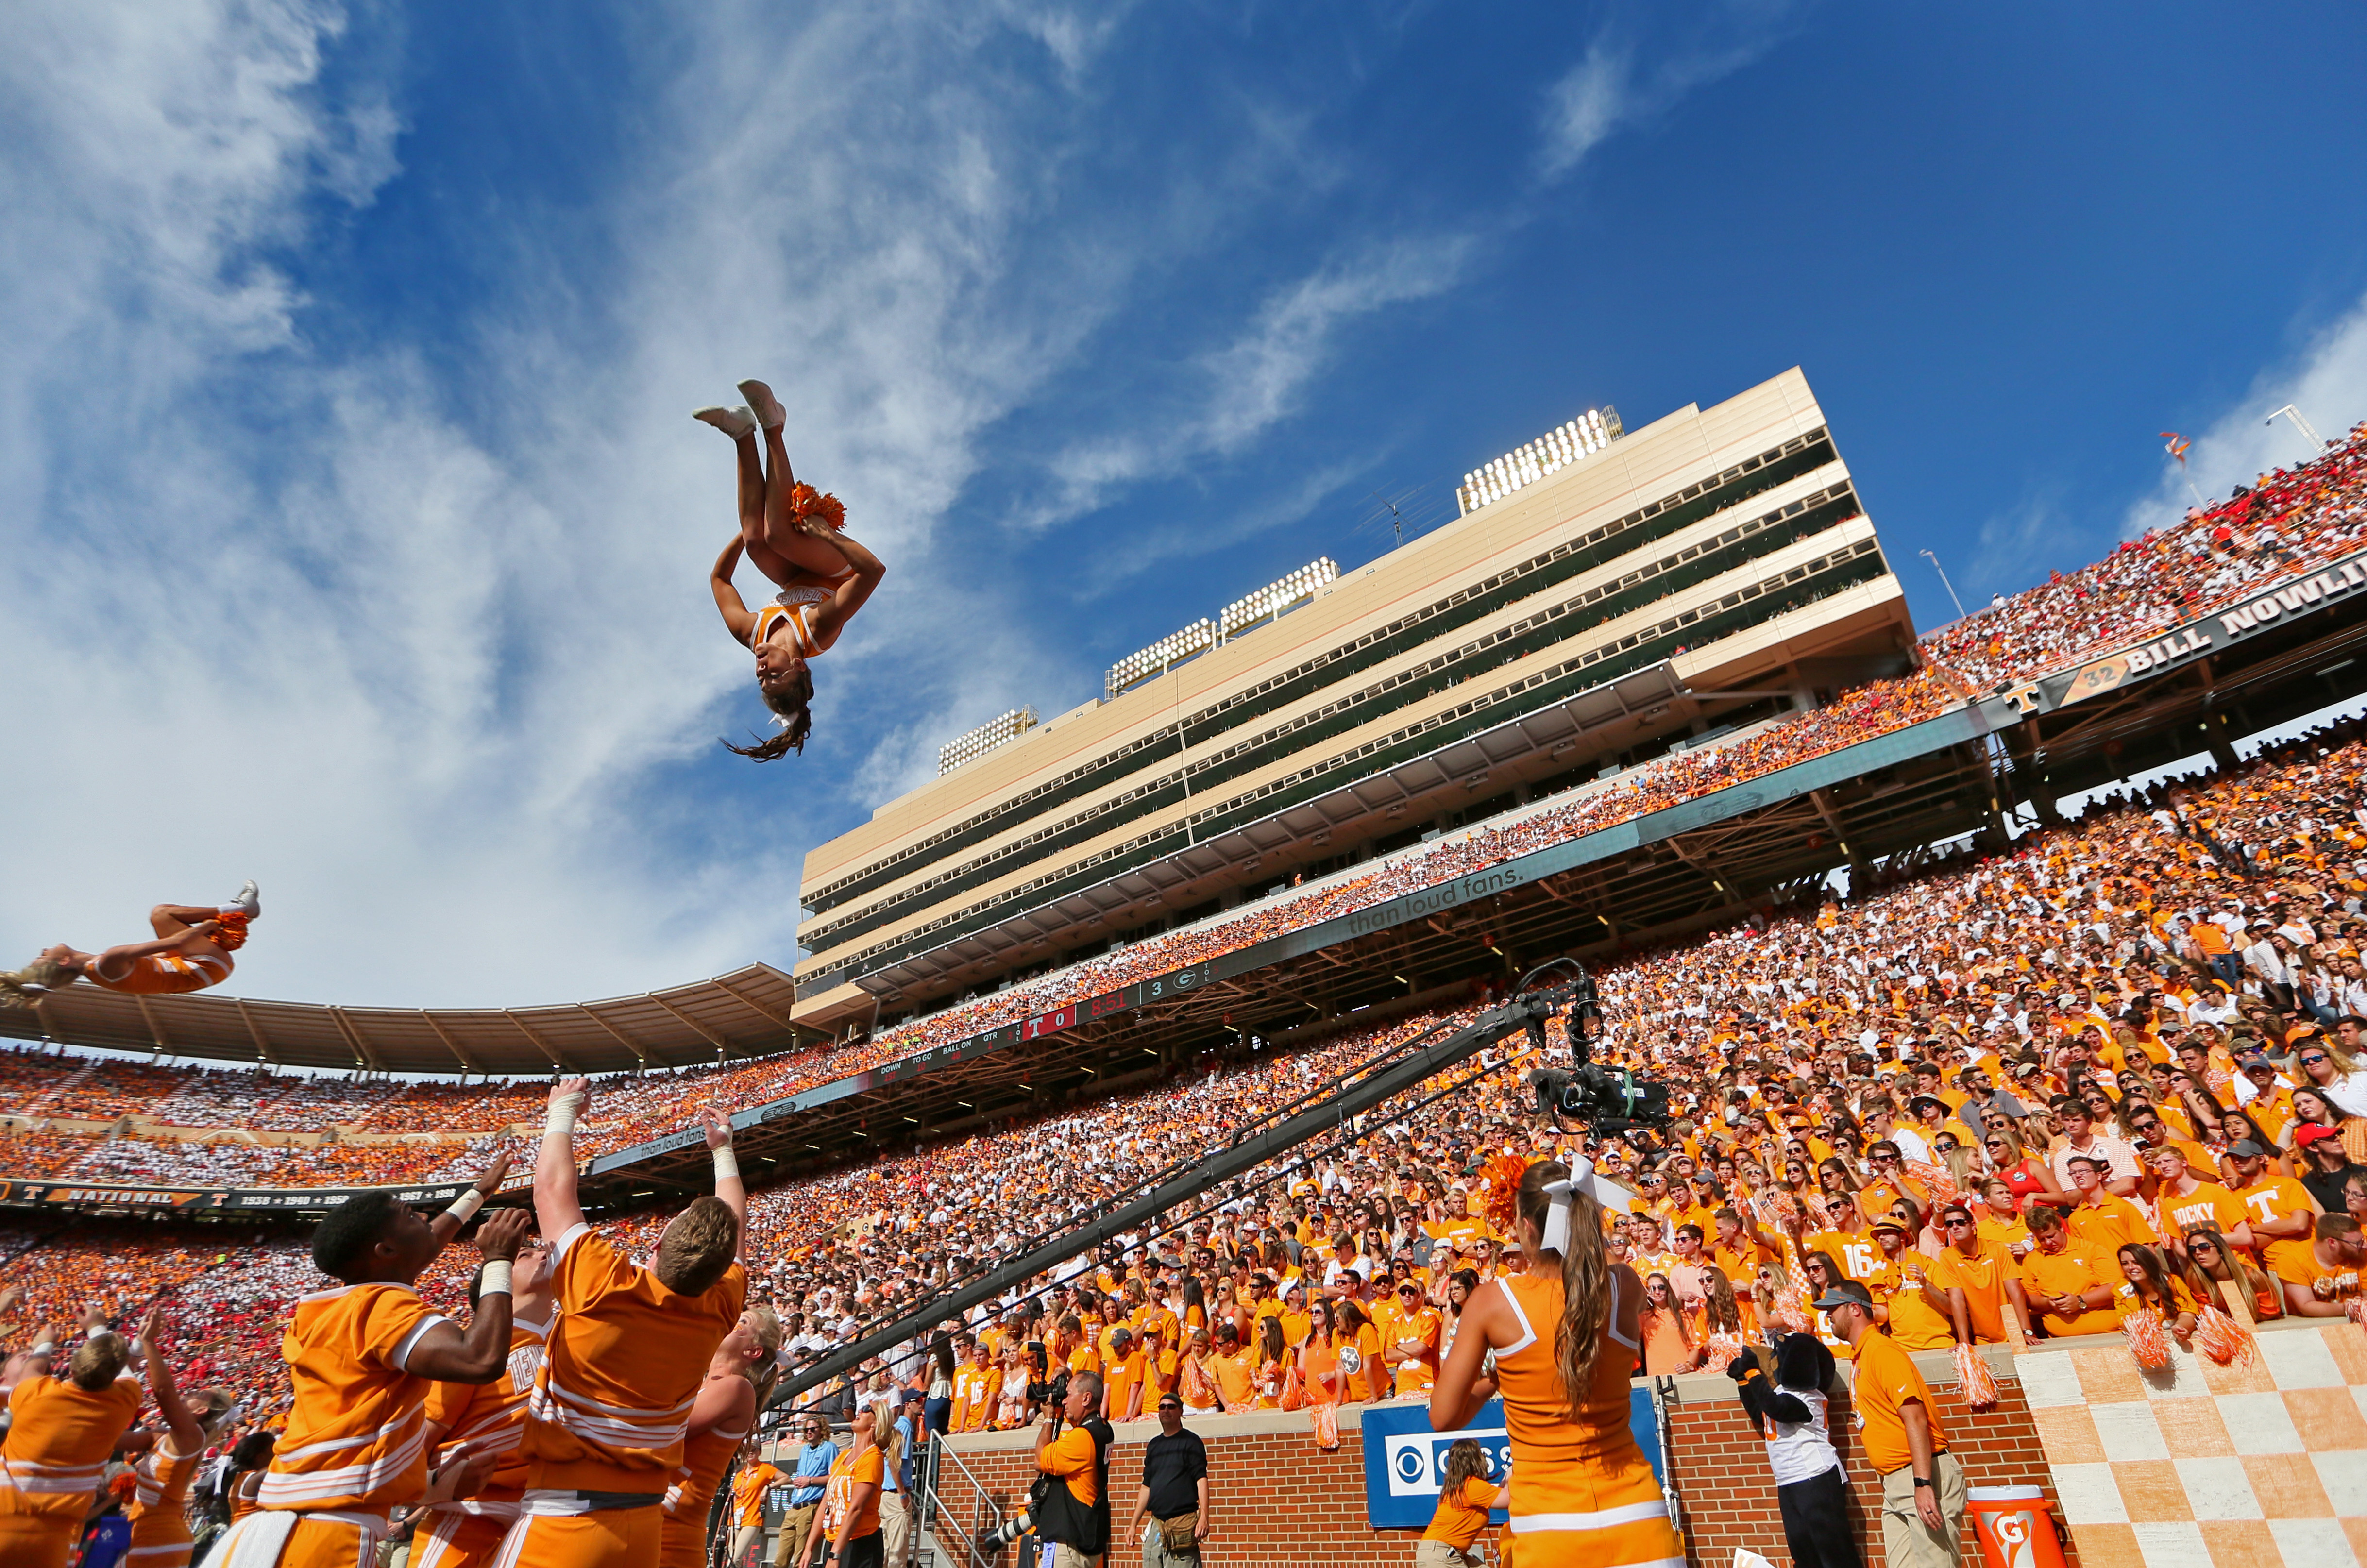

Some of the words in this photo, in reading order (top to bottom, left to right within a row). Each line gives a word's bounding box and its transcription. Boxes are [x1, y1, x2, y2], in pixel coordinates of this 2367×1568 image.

[2084, 666, 2117, 687] 32
[2125, 628, 2212, 674] BILL
[2219, 555, 2367, 635] NOWLI
[2002, 682, 2040, 715] T
[1348, 908, 1399, 934] than
[1405, 884, 1456, 916] loud
[1463, 869, 1524, 897] fans.
[1151, 981, 1162, 995] 3
[1091, 992, 1126, 1016] 8:51
[1029, 1016, 1043, 1038] T
[1055, 1013, 1064, 1026] 0
[983, 1032, 998, 1042] QTR
[943, 1044, 960, 1055] BALL
[961, 1040, 972, 1049] ON
[913, 1055, 921, 1064] TO
[922, 1053, 932, 1061] GO
[881, 1062, 901, 1074] DOWN
[2279, 1106, 2289, 1114] T
[641, 1144, 661, 1157] than
[663, 1135, 684, 1149] loud
[499, 1175, 535, 1191] CHAM
[24, 1186, 44, 1199] T
[68, 1190, 172, 1203] NATIONAL
[211, 1193, 229, 1206] T
[241, 1196, 271, 1205] 1938
[2245, 1189, 2280, 1224] T
[1843, 1244, 1873, 1277] 16
[970, 1381, 985, 1405] 16
[1437, 1447, 1495, 1474] CS
[1997, 1515, 2024, 1543] G
[1047, 1548, 1052, 1556] T
